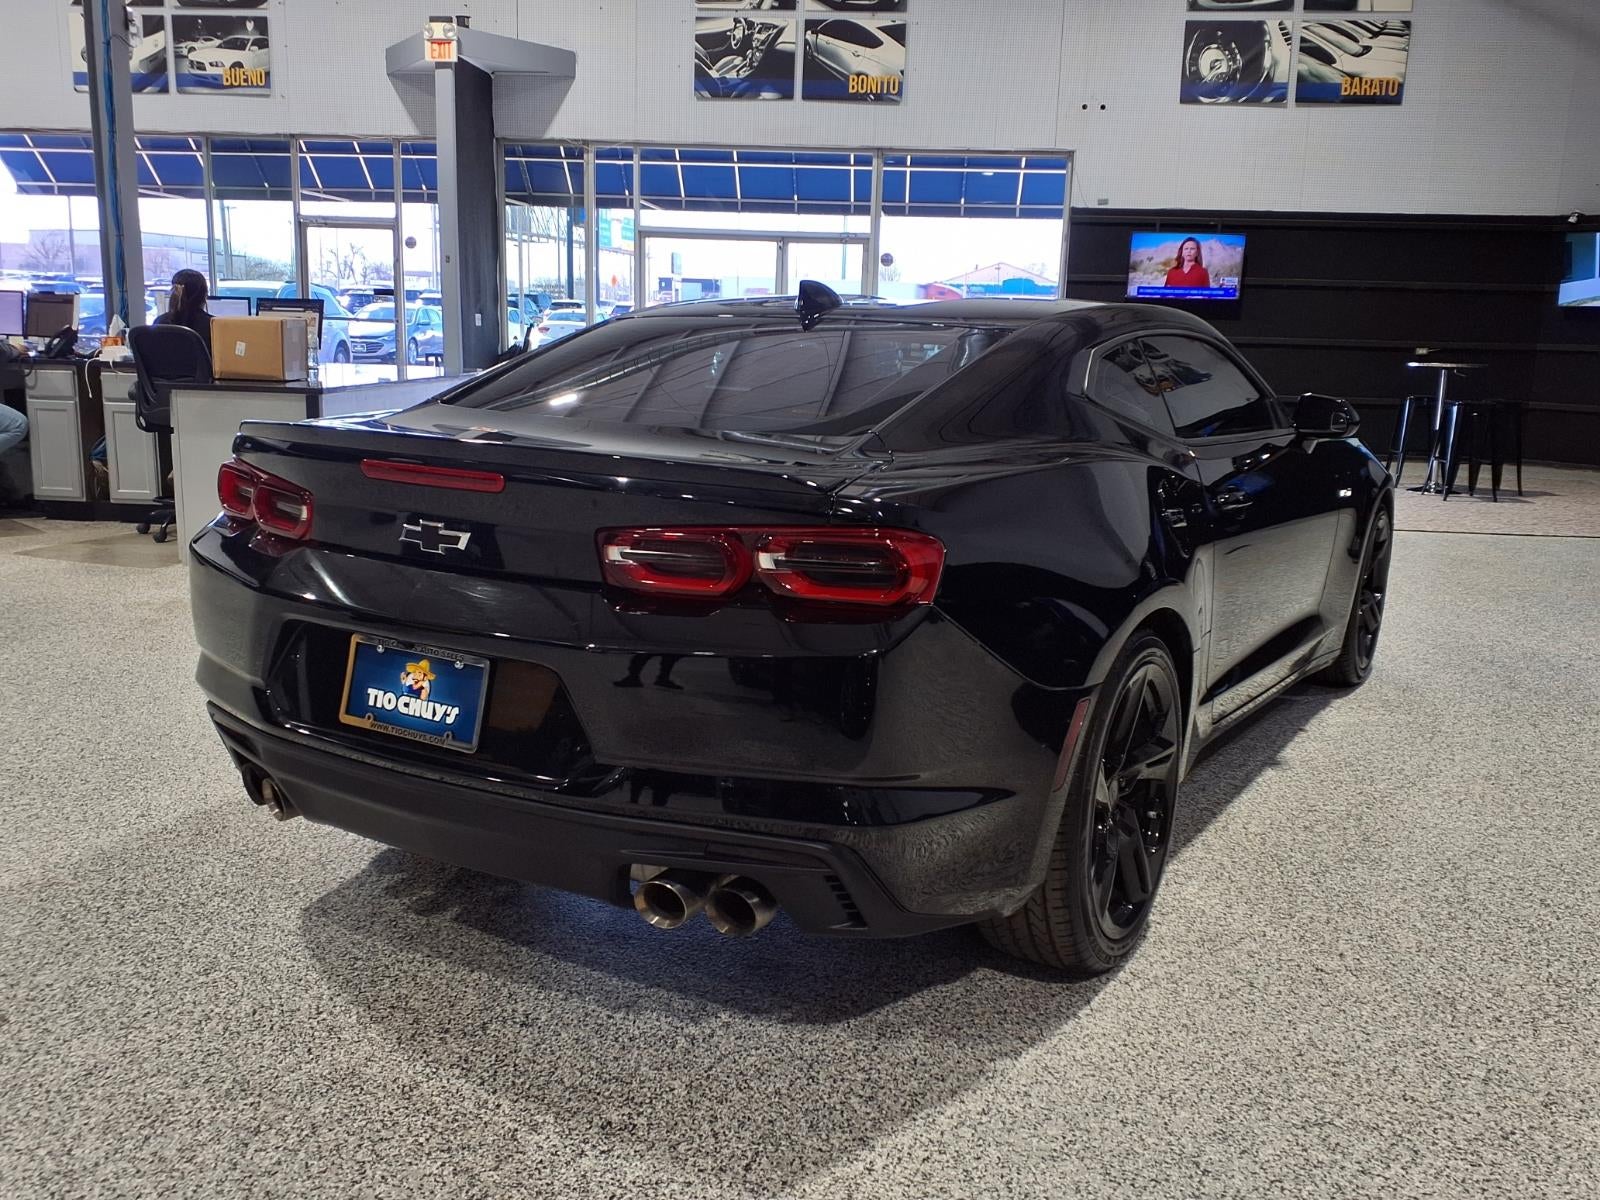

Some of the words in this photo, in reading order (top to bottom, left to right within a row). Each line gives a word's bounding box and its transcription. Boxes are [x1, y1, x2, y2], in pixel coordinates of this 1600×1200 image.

[430, 41, 452, 60] EXIT
[223, 67, 266, 86] BUENO
[848, 74, 899, 94] BONITO
[1341, 76, 1399, 96] BARATO
[420, 646, 439, 656] AUTO
[367, 687, 397, 711] TIO
[397, 695, 460, 725] CHUY'S
